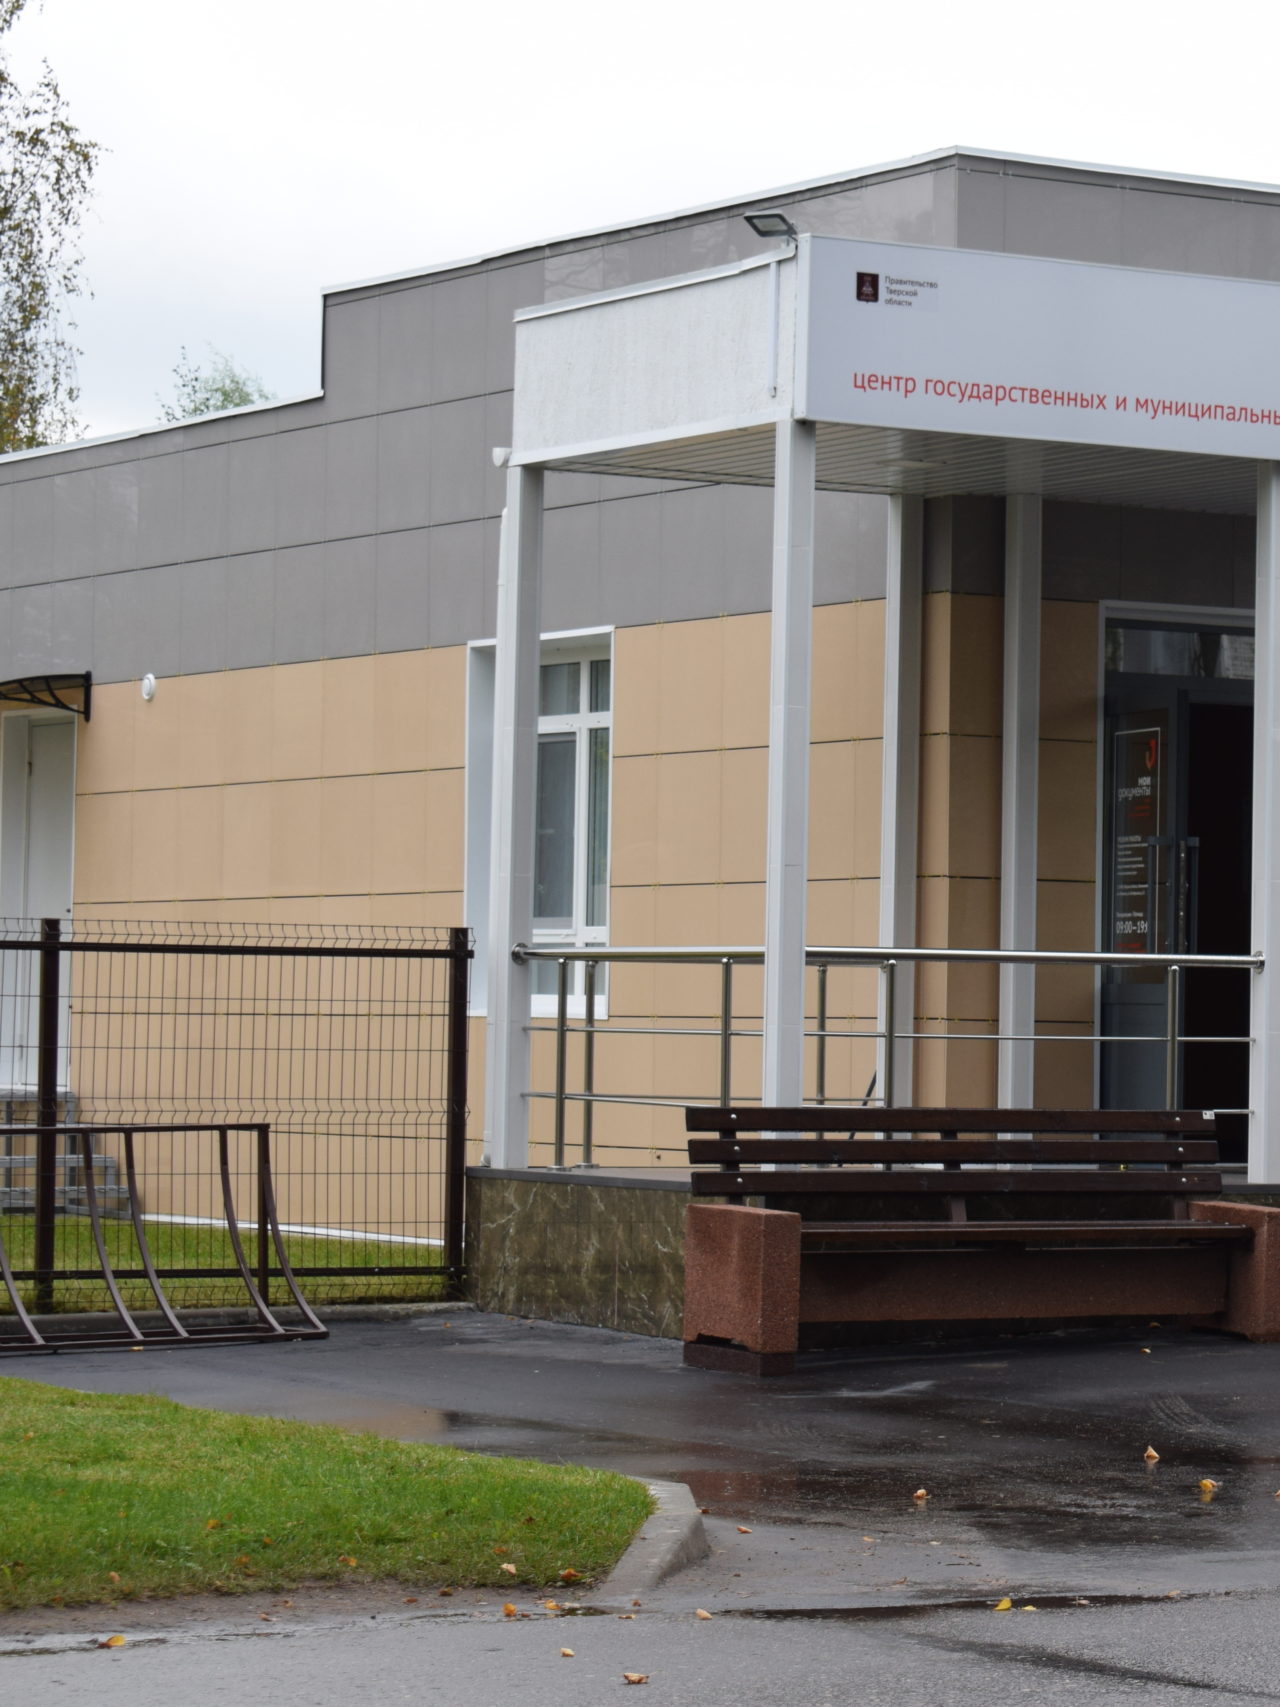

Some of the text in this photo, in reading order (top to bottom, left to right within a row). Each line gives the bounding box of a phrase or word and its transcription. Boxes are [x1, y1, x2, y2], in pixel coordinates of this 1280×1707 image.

[885, 275, 938, 289] Правительство
[886, 286, 918, 297] Тверской
[884, 298, 913, 307] области
[853, 372, 917, 398] центр
[925, 378, 1107, 410] государственных
[1115, 396, 1127, 412] и
